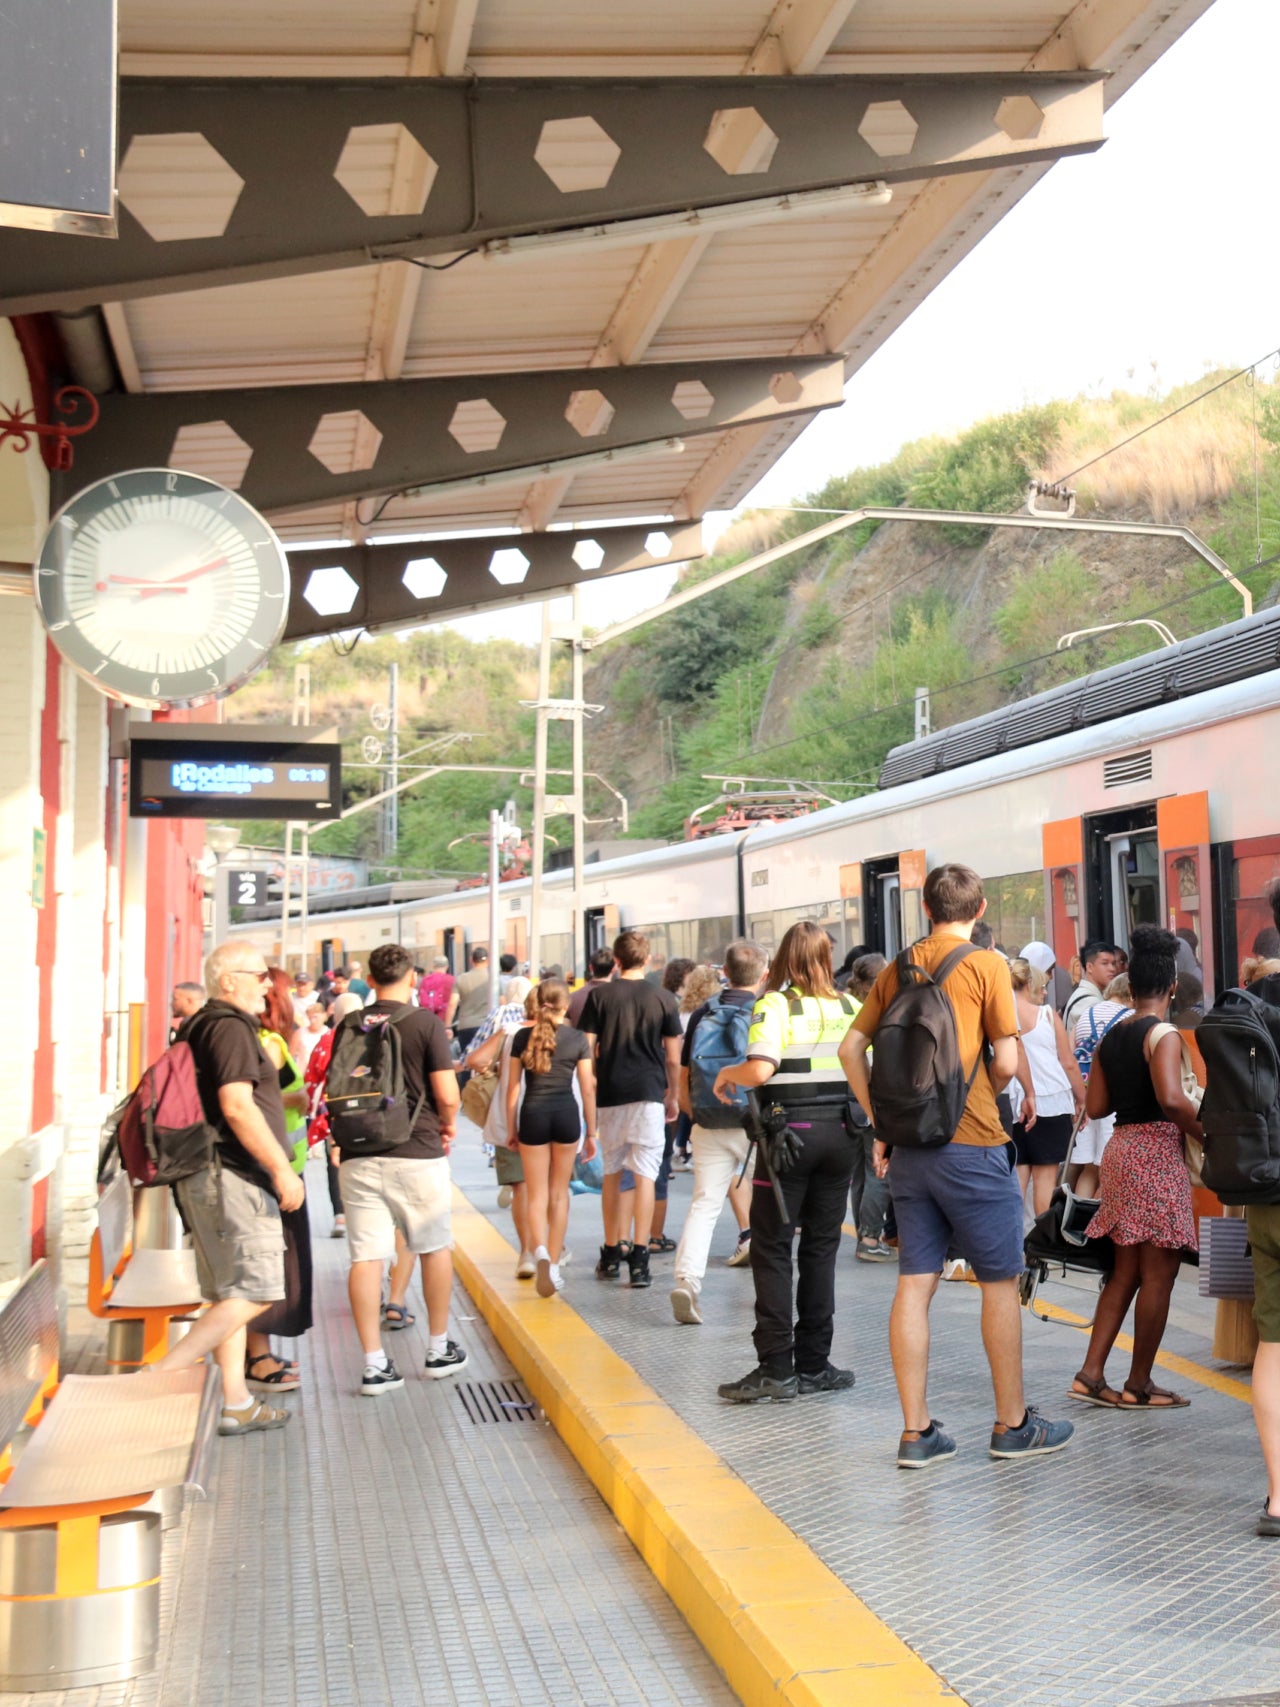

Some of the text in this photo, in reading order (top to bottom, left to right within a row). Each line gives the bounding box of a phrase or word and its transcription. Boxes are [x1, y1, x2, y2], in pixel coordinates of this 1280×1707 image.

[166, 473, 178, 491] 12
[94, 659, 109, 675] 7
[206, 668, 219, 686] 5
[151, 678, 160, 696] 6
[180, 762, 274, 783] Rodalies
[238, 882, 256, 904] 2
